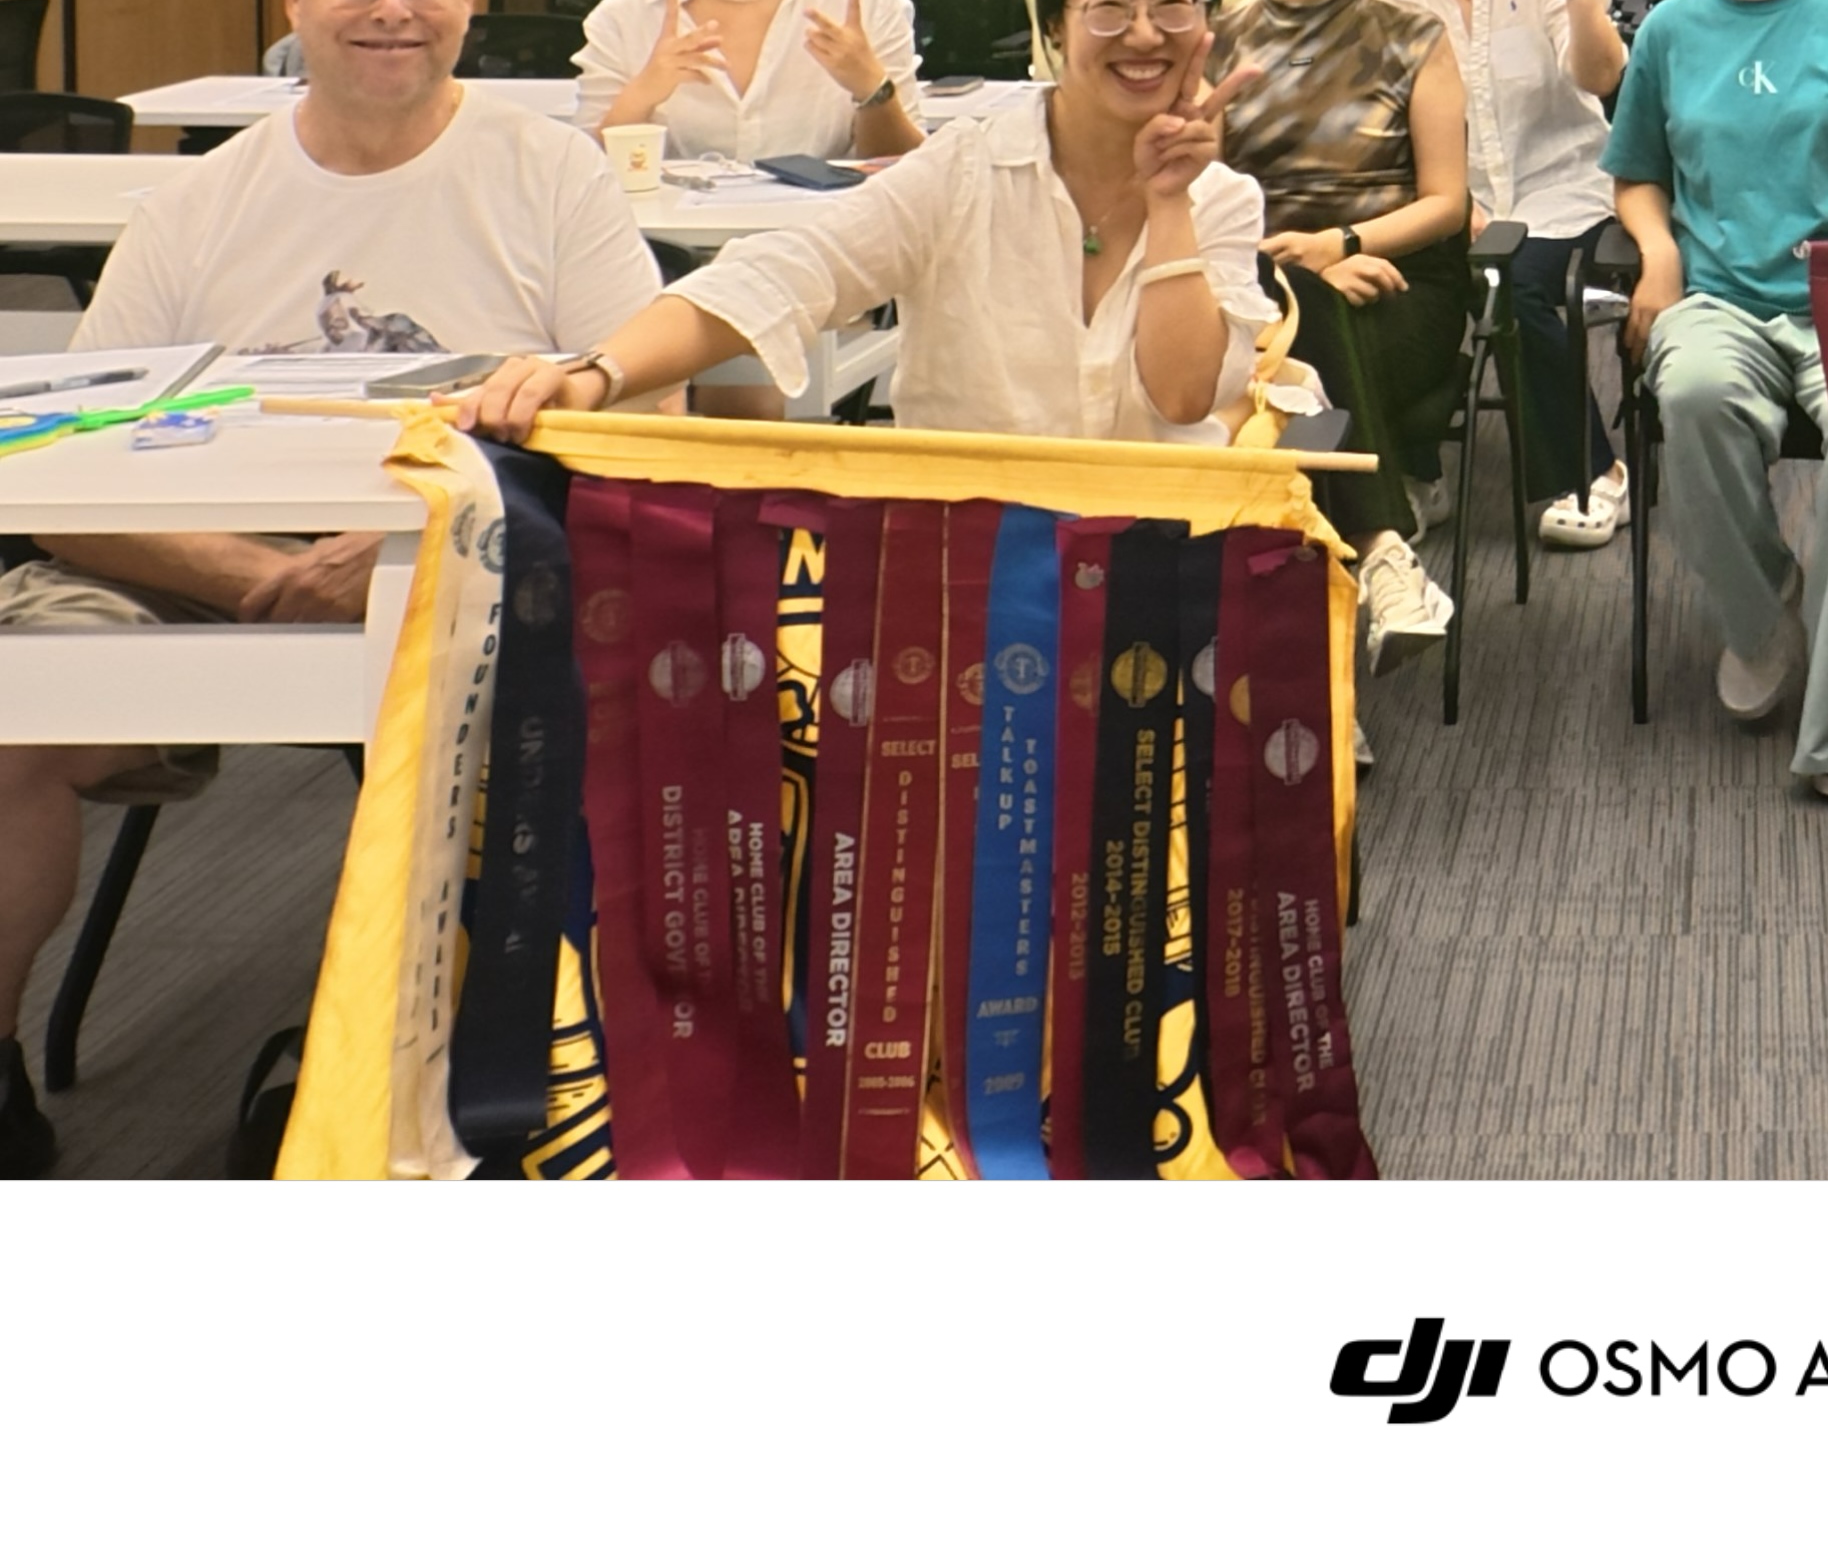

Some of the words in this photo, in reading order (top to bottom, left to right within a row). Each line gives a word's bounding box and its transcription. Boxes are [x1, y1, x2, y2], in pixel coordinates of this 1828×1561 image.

[881, 739, 937, 757] SELECT
[951, 752, 980, 769] SEL
[999, 705, 1015, 784] TALK
[1133, 728, 1157, 815] SELECT
[661, 784, 685, 902] DISTRICT
[998, 792, 1014, 831] UP
[749, 821, 765, 879] HOME
[832, 831, 856, 906] AREA
[1014, 738, 1038, 976] TOASTMASTERS
[751, 883, 767, 932] CLUB
[882, 770, 914, 1023] DISTINGUISHED
[1102, 839, 1125, 956] 2014-2015
[1126, 821, 1152, 995] DISTINGUISHED
[1277, 891, 1300, 961] AREA
[1304, 899, 1322, 952] HOME
[753, 936, 767, 964] OF
[1224, 888, 1245, 998] 2017-2018
[825, 912, 853, 1048] DIRECTOR
[976, 996, 1039, 1019] AWARD
[1307, 955, 1326, 1002] CLUB
[864, 1040, 912, 1060] CLUB
[1282, 963, 1316, 1094] DIRECTOR
[1318, 1031, 1334, 1070] THE
